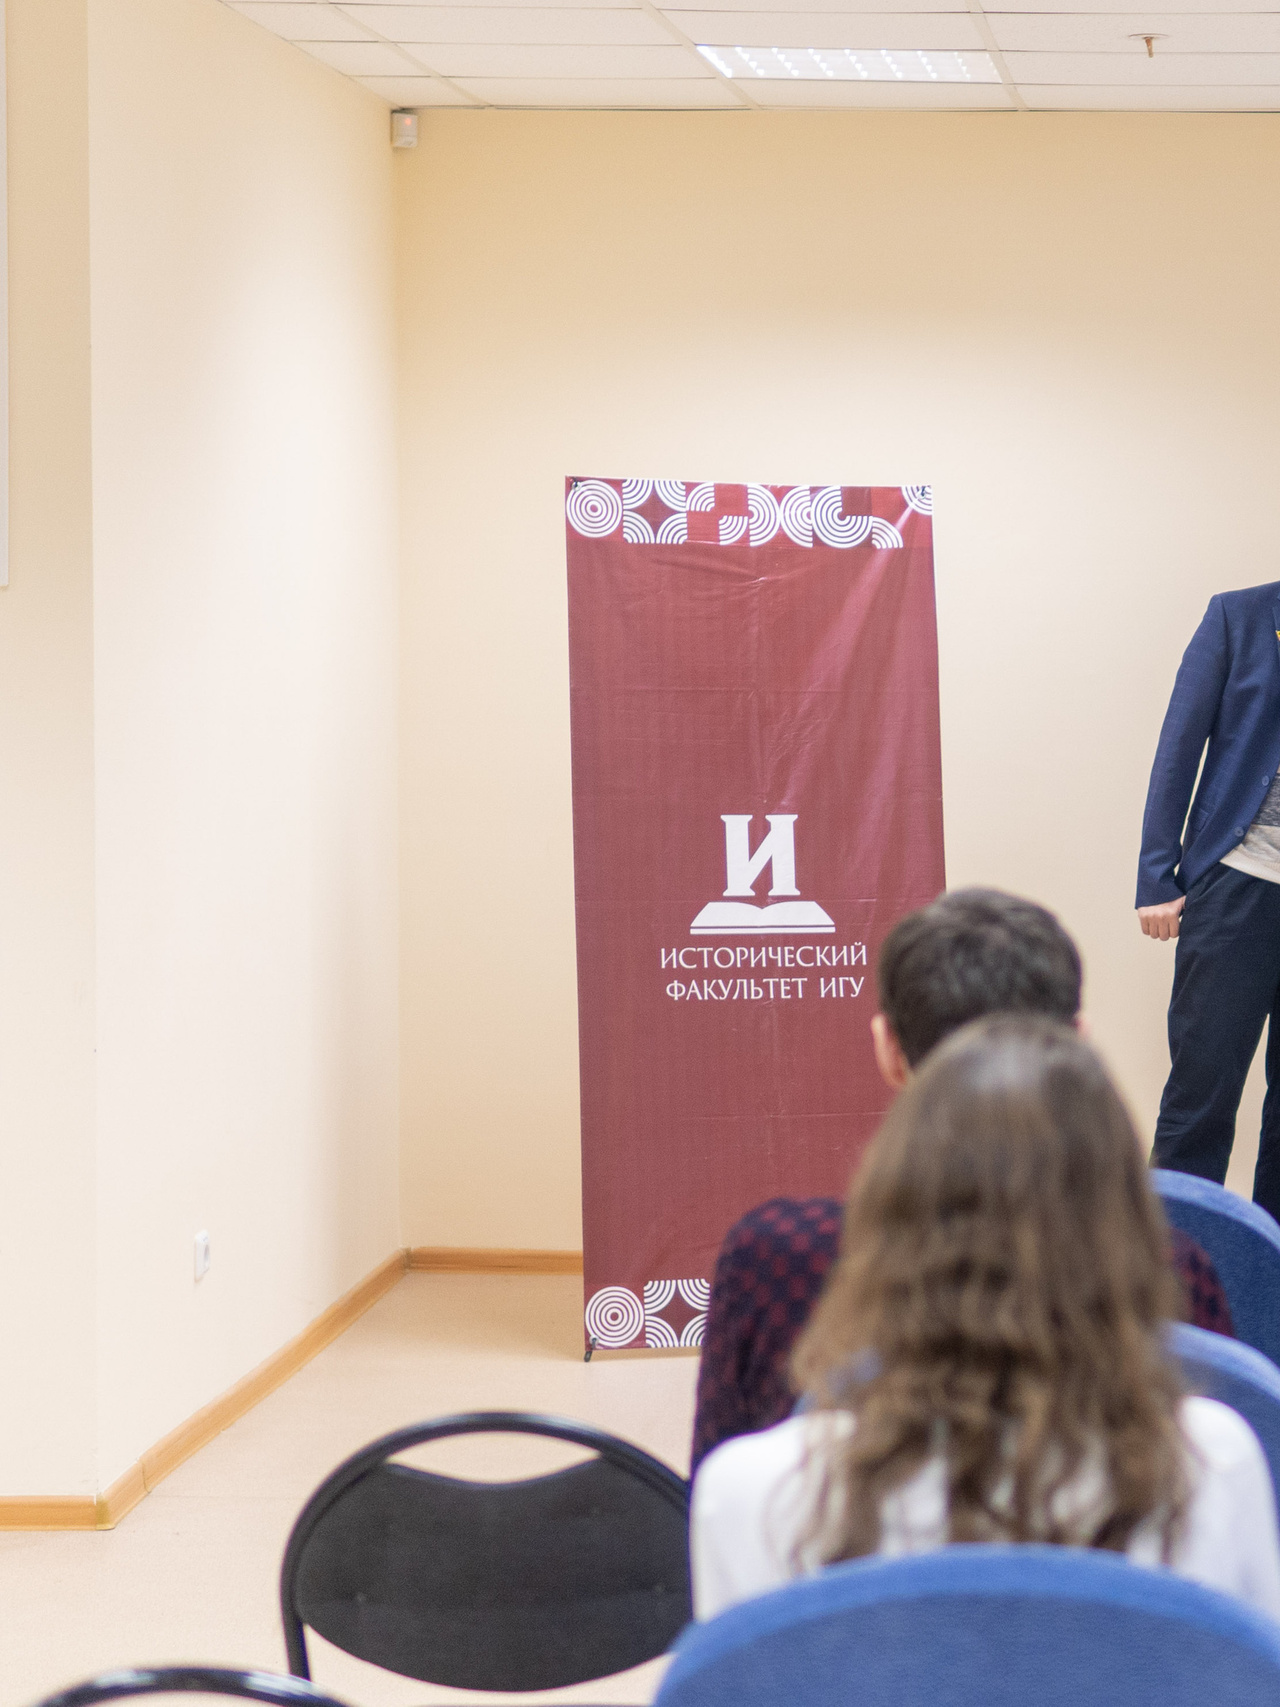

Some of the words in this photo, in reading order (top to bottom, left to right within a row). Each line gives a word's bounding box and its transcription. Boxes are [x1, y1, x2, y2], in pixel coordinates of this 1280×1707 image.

[720, 814, 800, 896] И
[660, 941, 867, 969] ИСТОРИЧЕСКИЙ
[666, 977, 807, 1001] ФАКУЛЬТЕТ
[820, 976, 865, 998] ИГУ
